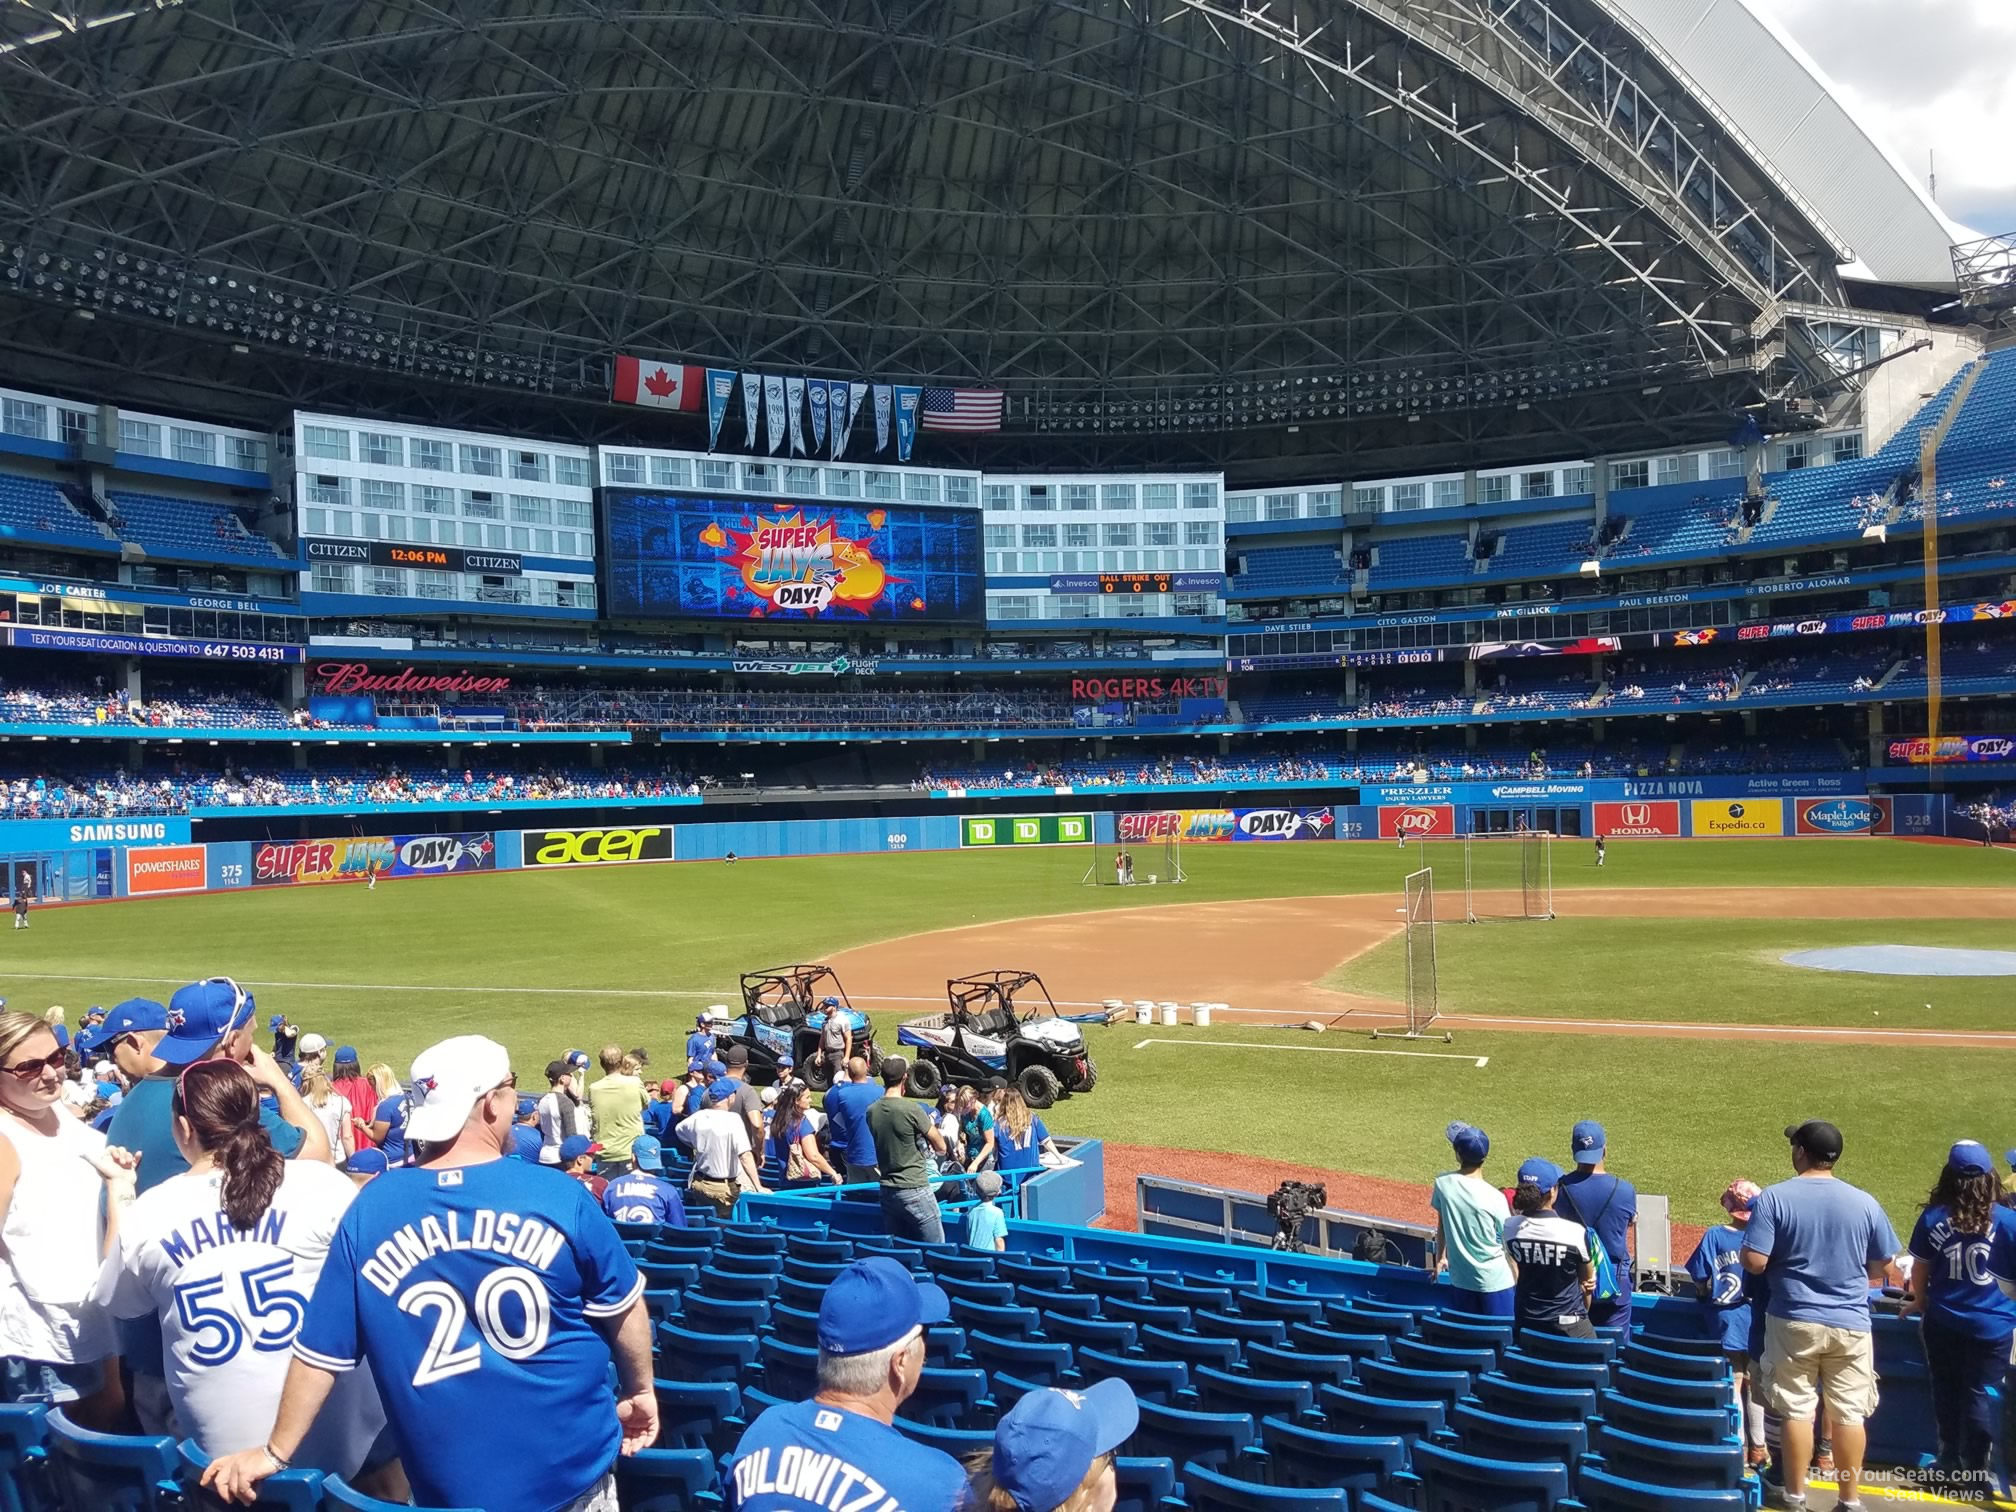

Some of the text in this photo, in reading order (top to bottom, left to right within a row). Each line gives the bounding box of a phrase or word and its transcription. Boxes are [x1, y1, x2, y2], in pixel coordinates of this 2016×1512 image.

[758, 526, 818, 549] SUPER
[309, 543, 368, 558] CITIZEN
[391, 549, 447, 564] 12:06 PM
[466, 556, 520, 569] CITIZEN
[753, 544, 834, 584] JAYS
[39, 583, 106, 599] JOE CARTER
[1105, 583, 1167, 593] 0 0 0
[1758, 582, 1803, 594] ROBERTO
[1808, 577, 1850, 589] ALOMAR
[780, 587, 821, 605] DAY!
[1619, 594, 1689, 607] PAUL BEESTON
[190, 598, 260, 611] GEORGE BELL
[1497, 606, 1551, 618] PAT GILLICK
[1265, 623, 1311, 632] DAVE STIEB
[1377, 615, 1436, 627] CITO GASTON
[1852, 614, 1885, 630] SUPER
[1738, 625, 1769, 640] SUPER
[1801, 621, 1823, 633] DAY!
[31, 633, 284, 660] TEXT YOUR SEAT LOCATION & QUESTION TO 647 503 4131
[852, 660, 879, 668] FLIGHT
[855, 667, 875, 675] DECK
[317, 663, 511, 693] Budweiser
[1072, 678, 1161, 698] ROGERS
[1889, 742, 1931, 758] SUPER
[1977, 741, 2008, 753] DAY!
[1624, 781, 1703, 796] PIZZA NOVA
[1748, 778, 1841, 787] Active Green Ross
[1381, 787, 1452, 795] PRESZLER
[1120, 811, 1295, 839] SUPER JAYS DAY!
[1342, 823, 1362, 832] 375
[1403, 814, 1431, 830] DQ
[1709, 820, 1765, 831] Expedia.ca
[1905, 815, 1931, 826] 328
[70, 823, 165, 842] SAMSUNG
[972, 824, 993, 839] TD
[1016, 822, 1037, 838] TD
[1061, 821, 1082, 837] TD
[1611, 827, 1662, 835] HONDA
[536, 828, 660, 863] acer
[888, 834, 907, 843] 400
[257, 838, 458, 880] SUPER JAYS DAY!
[221, 865, 242, 877] 375
[159, 1208, 287, 1269] MARIN
[361, 1208, 566, 1297] DONALDSON
[1511, 1241, 1567, 1267] STAFF
[174, 1255, 305, 1367] 55
[397, 1266, 550, 1388] 20
[734, 1446, 906, 1512] TULOWITZ
